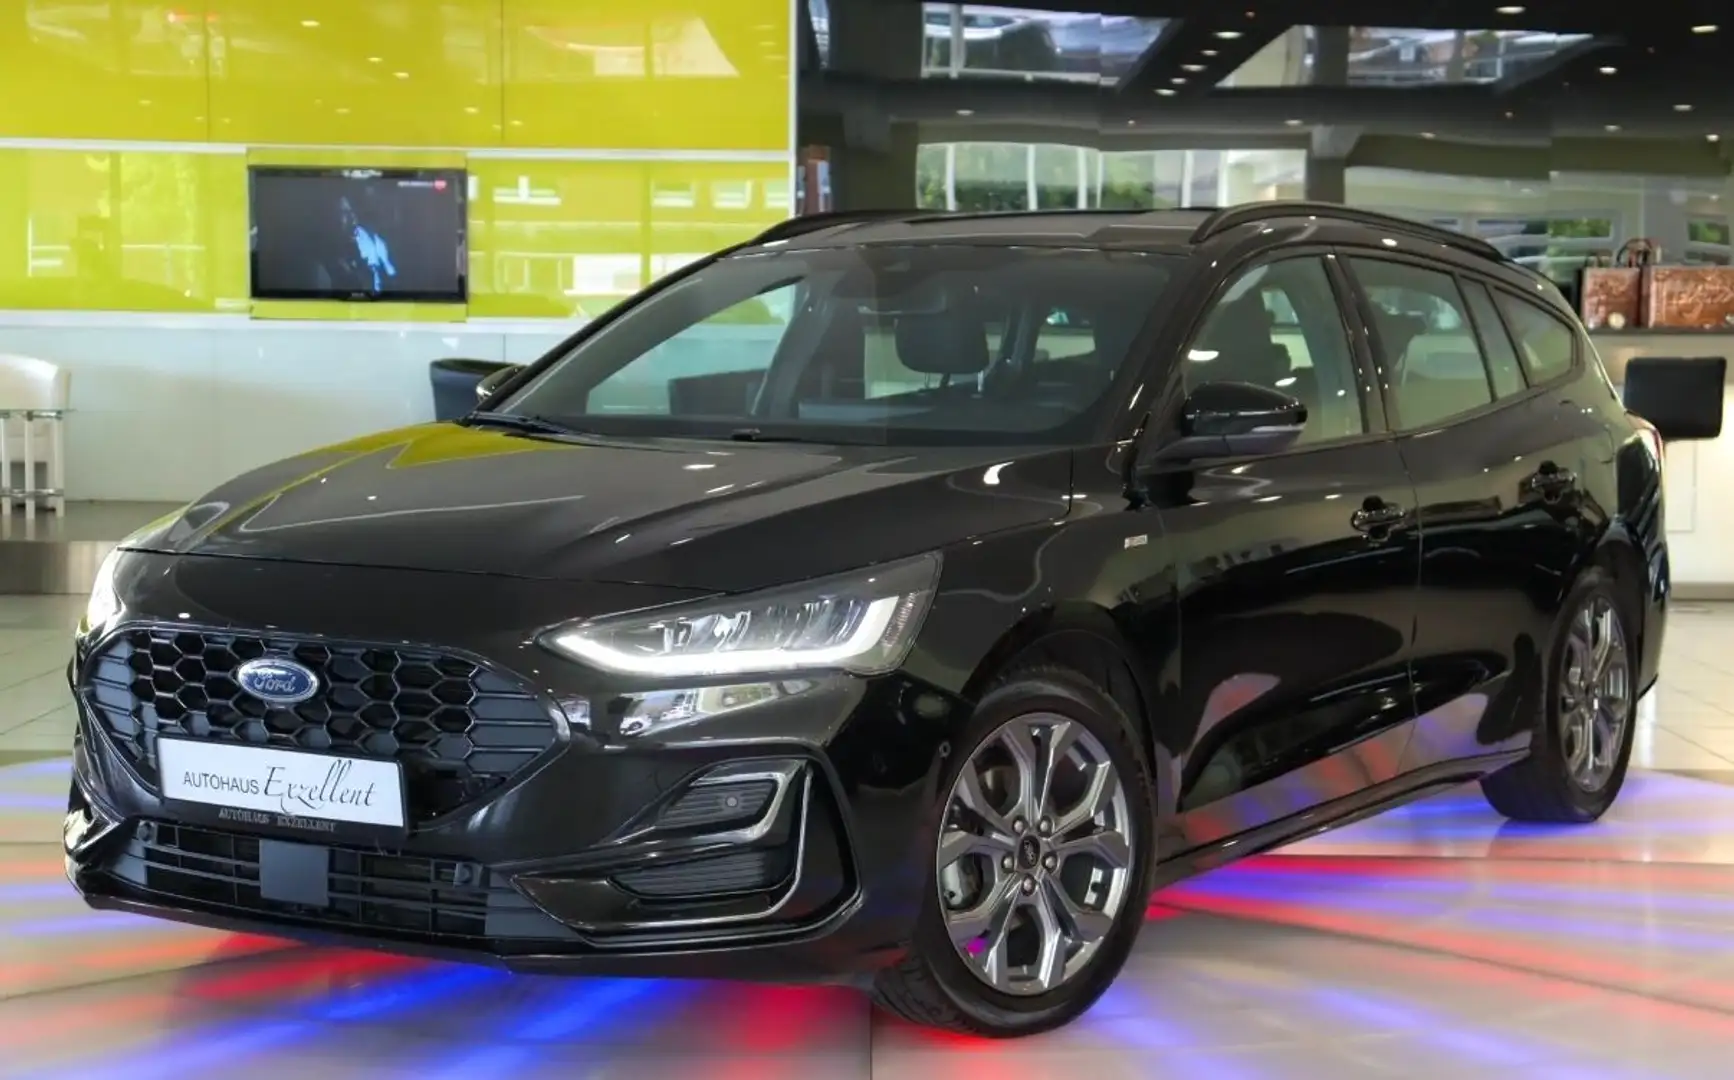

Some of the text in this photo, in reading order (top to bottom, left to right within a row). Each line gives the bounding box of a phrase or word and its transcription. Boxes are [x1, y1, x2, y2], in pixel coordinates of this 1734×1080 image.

[252, 669, 297, 693] Ford
[183, 759, 376, 815] AUTOHAUS Exzellent
[218, 807, 336, 833] AUTOHAUS EXZELLENT
